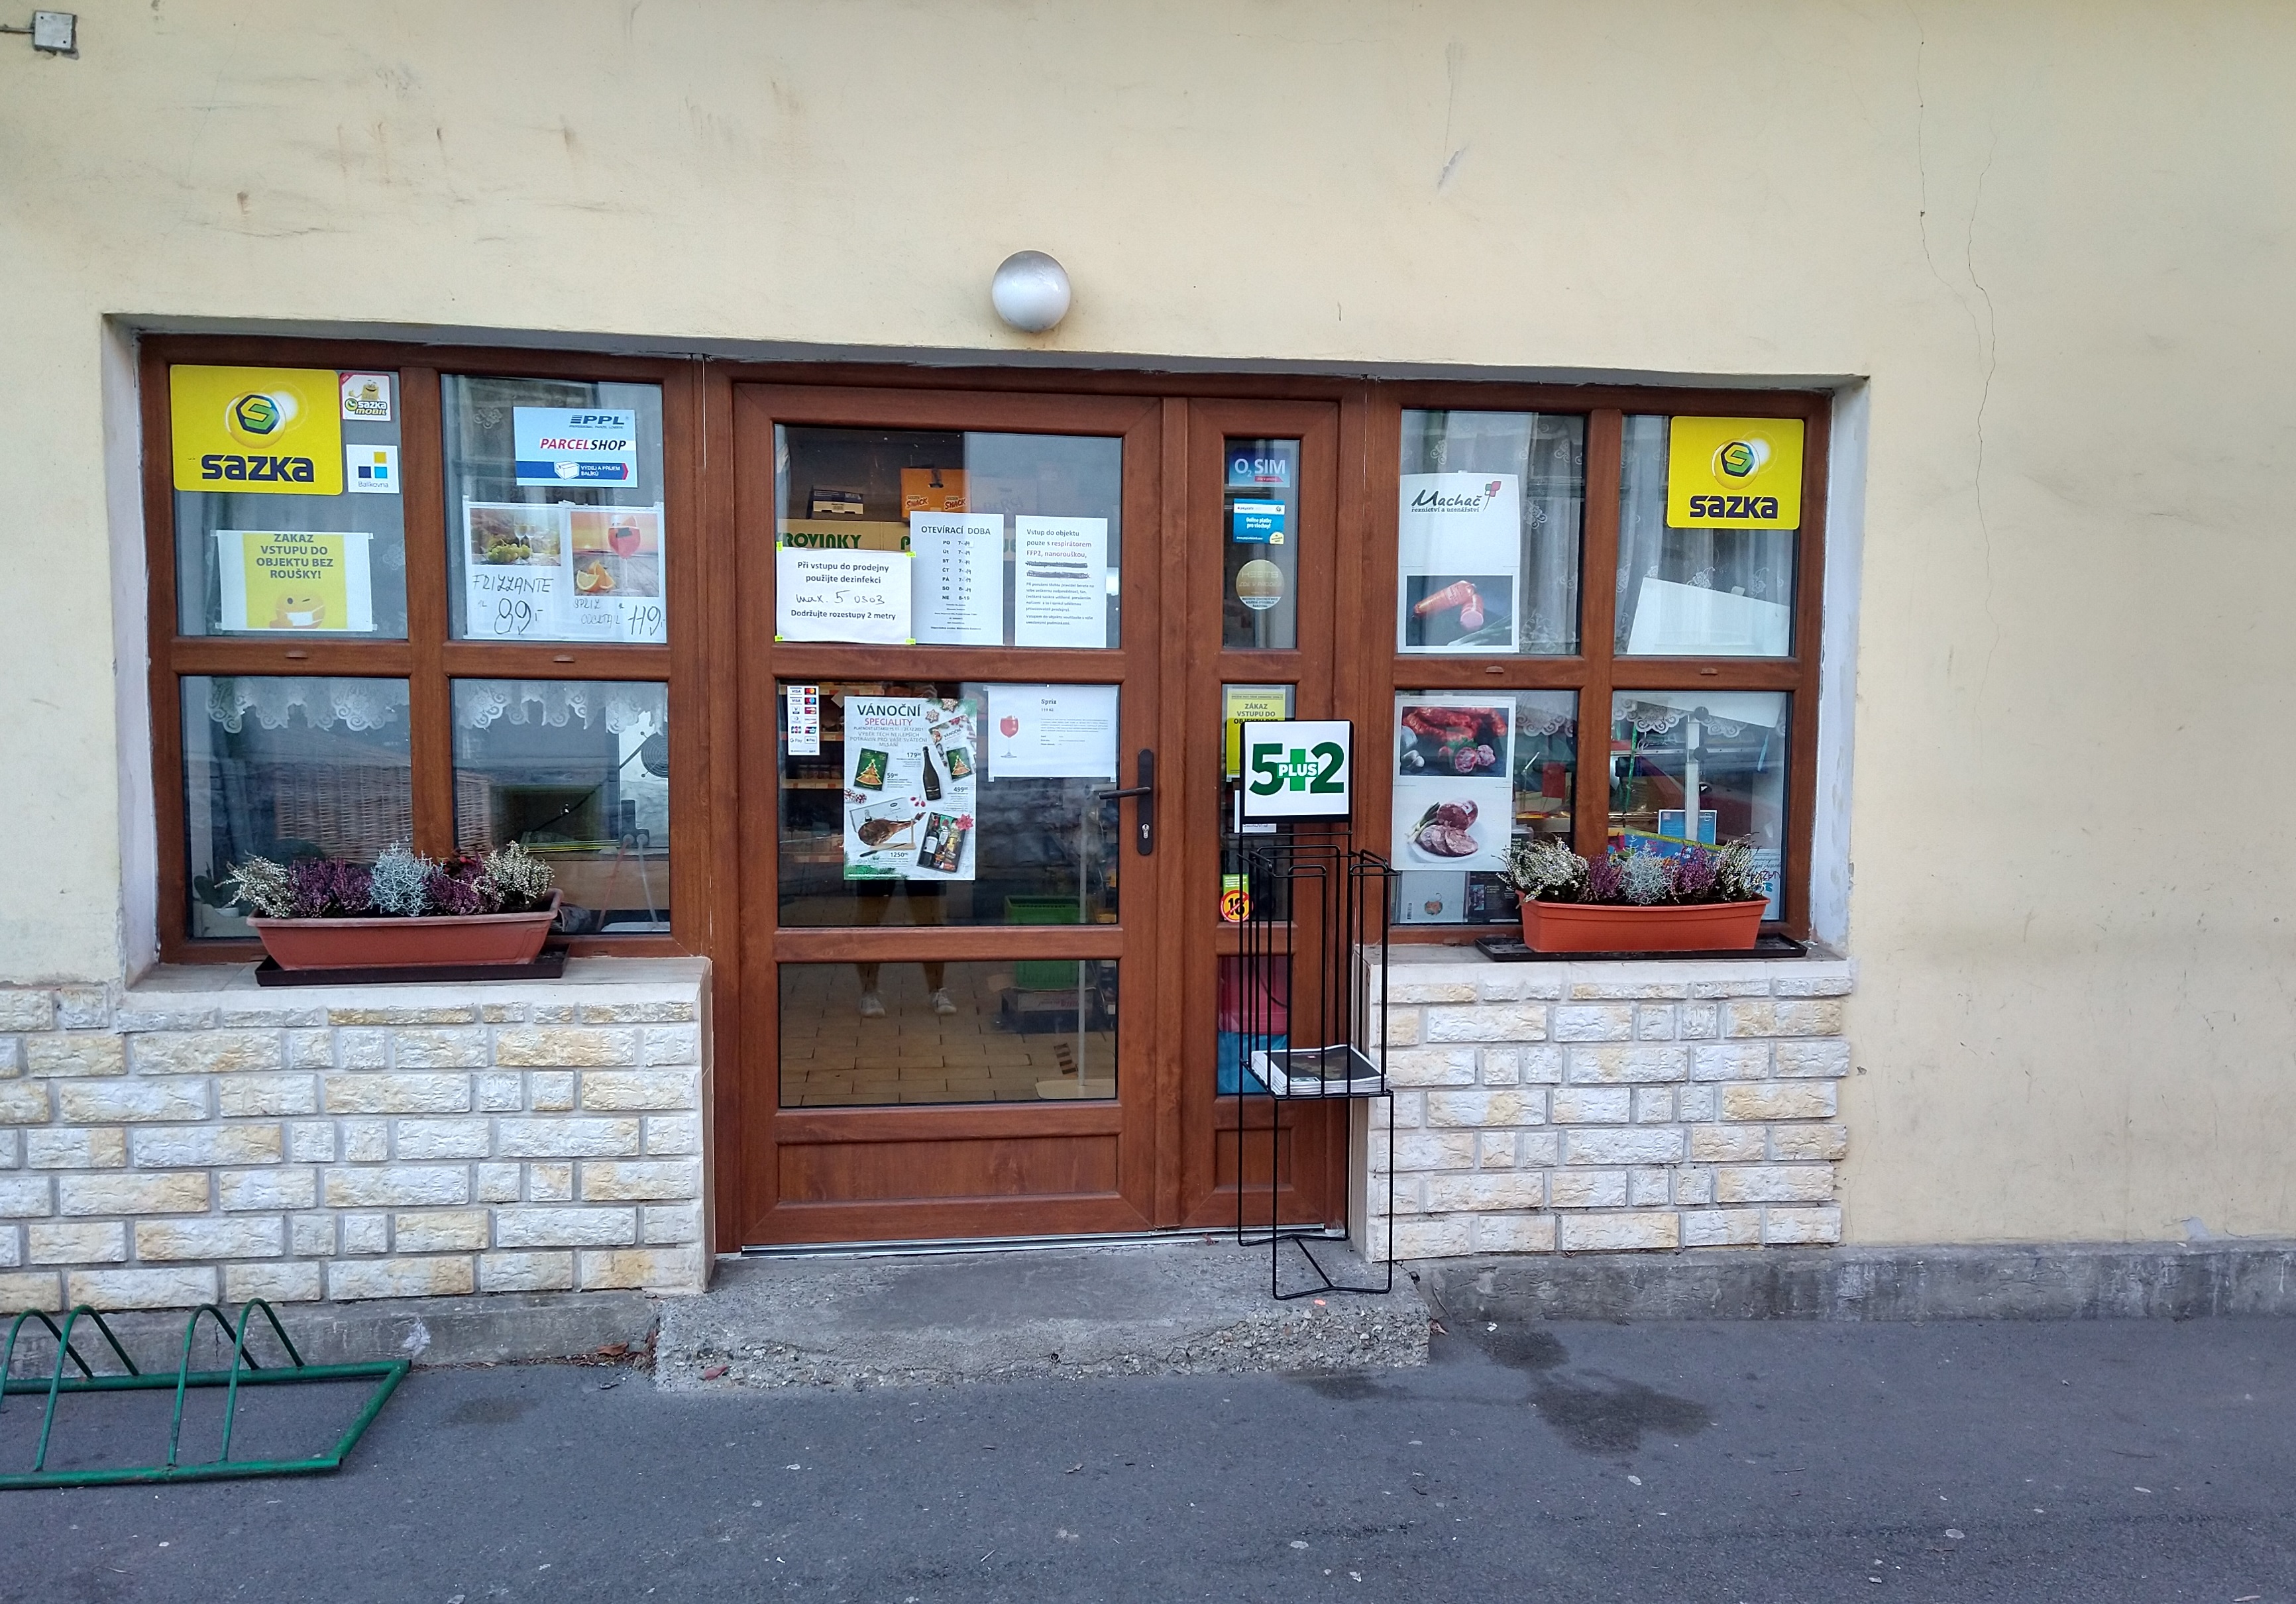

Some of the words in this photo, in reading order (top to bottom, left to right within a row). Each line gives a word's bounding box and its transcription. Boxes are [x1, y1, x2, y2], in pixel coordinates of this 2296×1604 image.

[582, 415, 625, 425] PPL
[539, 439, 626, 451] PARCELSHOP
[1254, 458, 1285, 474] SIM
[1411, 489, 1483, 506] Machač
[945, 498, 966, 510] SNACK
[921, 525, 963, 534] OTEVÍRACÍ
[781, 532, 861, 549] ROVINKY
[260, 545, 307, 555] VSTUPU
[311, 547, 328, 555] DO
[256, 557, 309, 567] OBJEKTU
[312, 559, 333, 567] BEZ
[853, 563, 889, 572] prodejny
[270, 568, 321, 579] ROUŠKY!
[806, 574, 838, 583] použijte
[472, 574, 554, 594] FRIZZANTE
[834, 590, 851, 604] 5
[791, 610, 828, 618] Dodržujte
[857, 703, 921, 716] VÁNOČNÍ
[1249, 743, 1285, 796] 5
[1278, 763, 1317, 776] PLUS
[1310, 741, 1344, 794] 2
